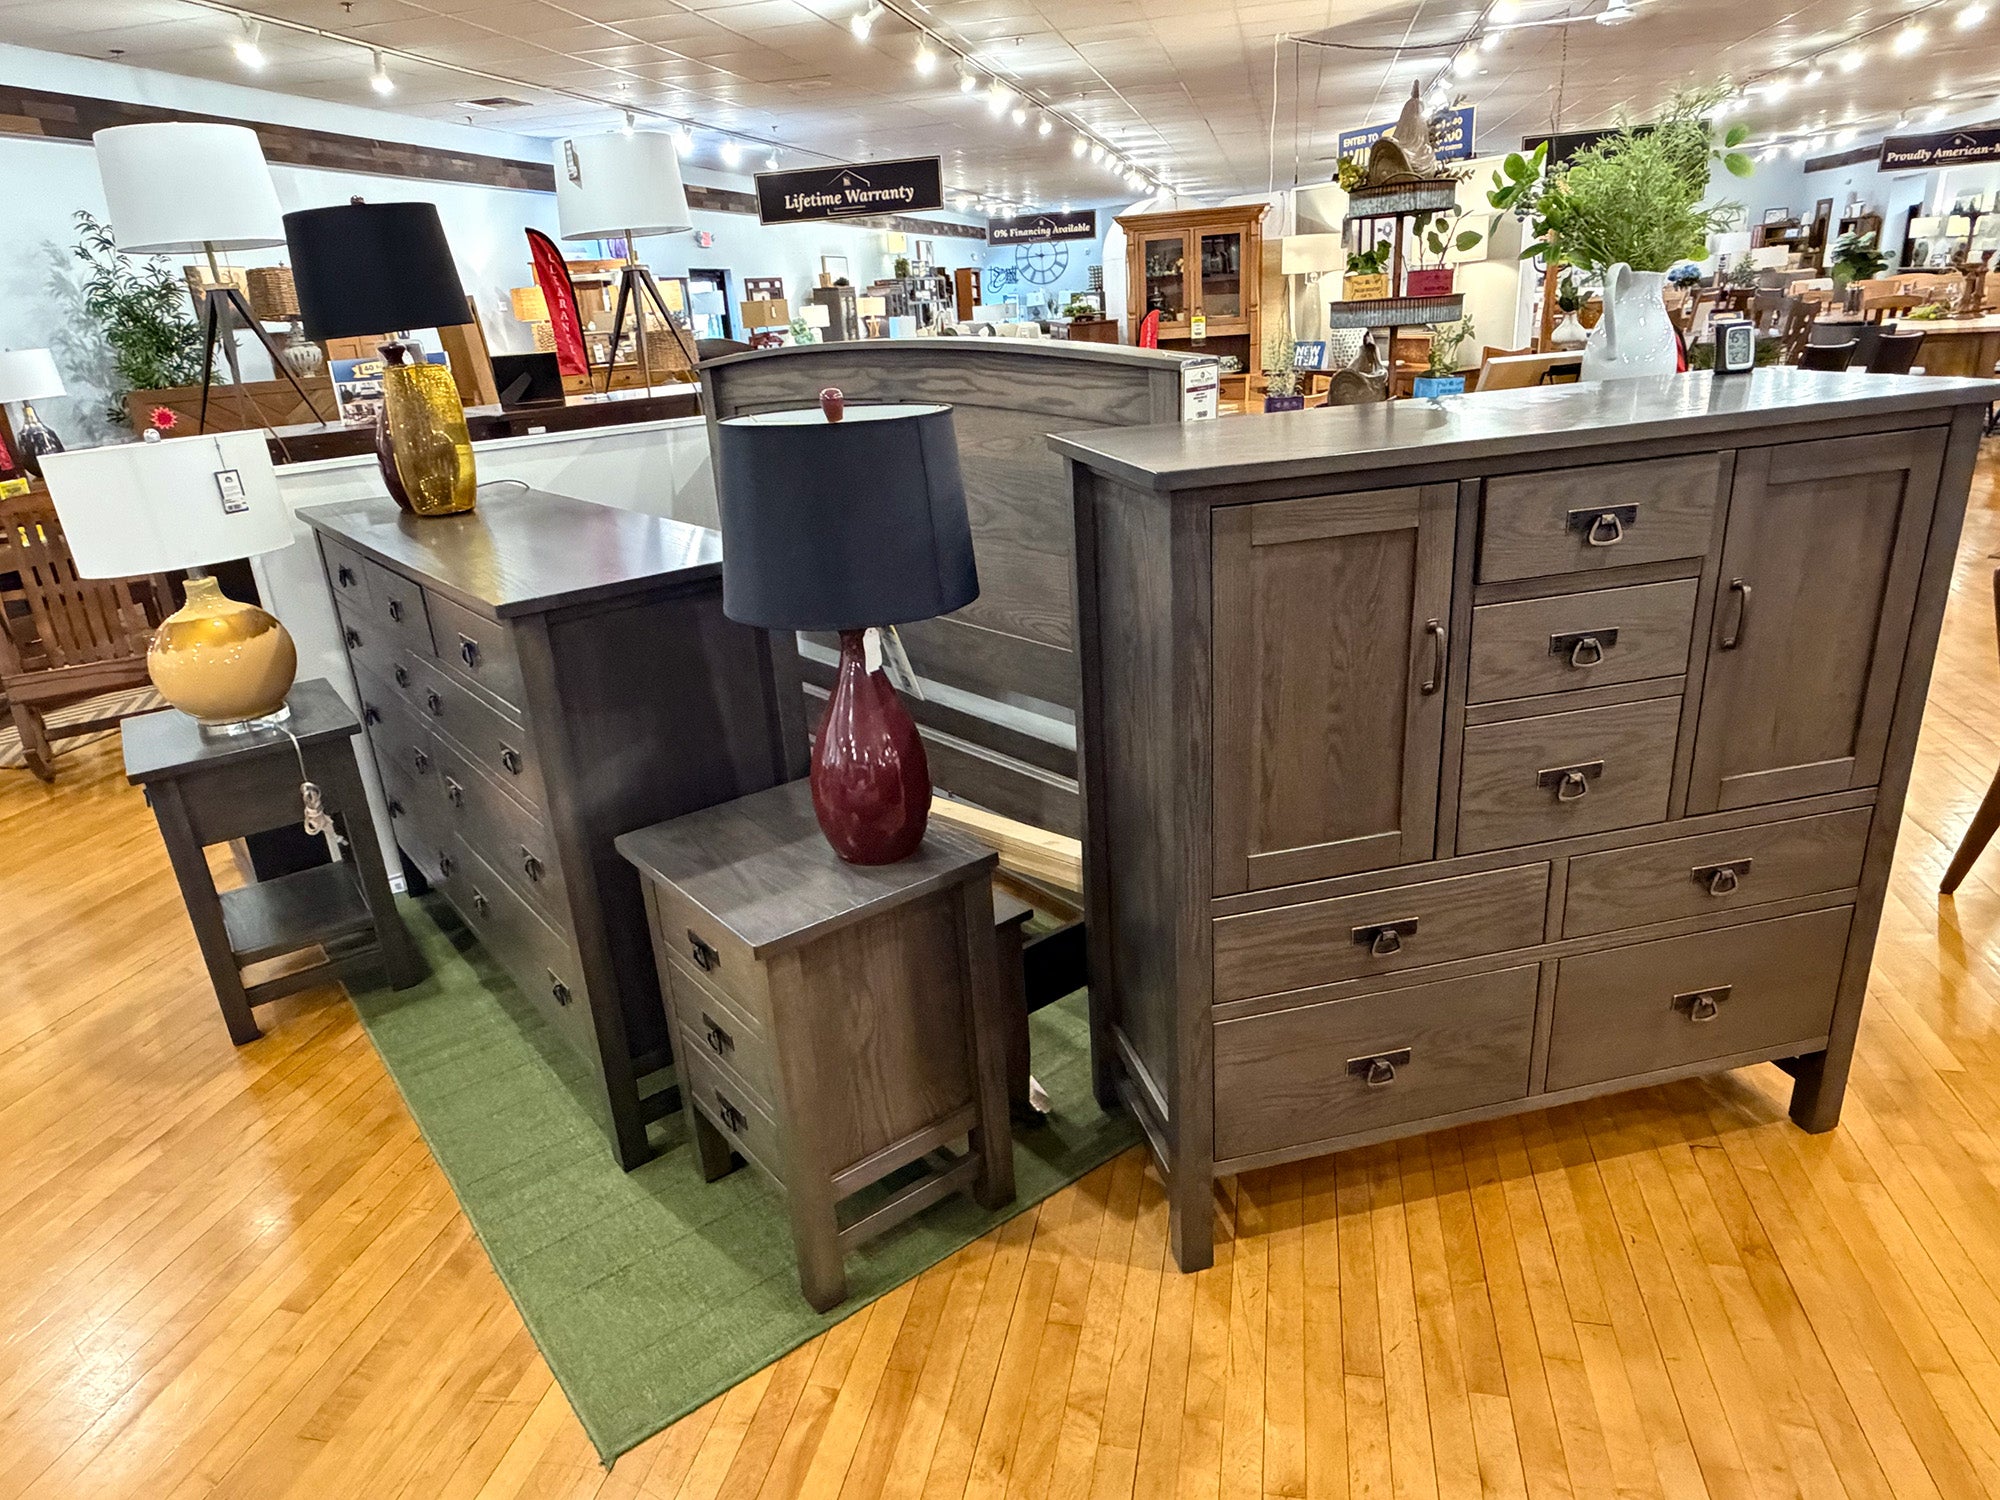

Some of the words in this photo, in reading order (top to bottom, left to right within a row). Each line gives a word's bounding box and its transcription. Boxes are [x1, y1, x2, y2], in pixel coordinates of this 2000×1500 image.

[1343, 135, 1367, 148] ENTER
[1367, 132, 1379, 143] TO
[1886, 149, 1932, 162] Proudly
[784, 191, 842, 212] Lifetime
[844, 185, 915, 204] Warranty
[993, 229, 1008, 238] 0%
[1009, 226, 1051, 237] Financing
[1052, 222, 1091, 234] Available
[1296, 345, 1321, 356] NEW
[1294, 355, 1319, 366] ITEM
